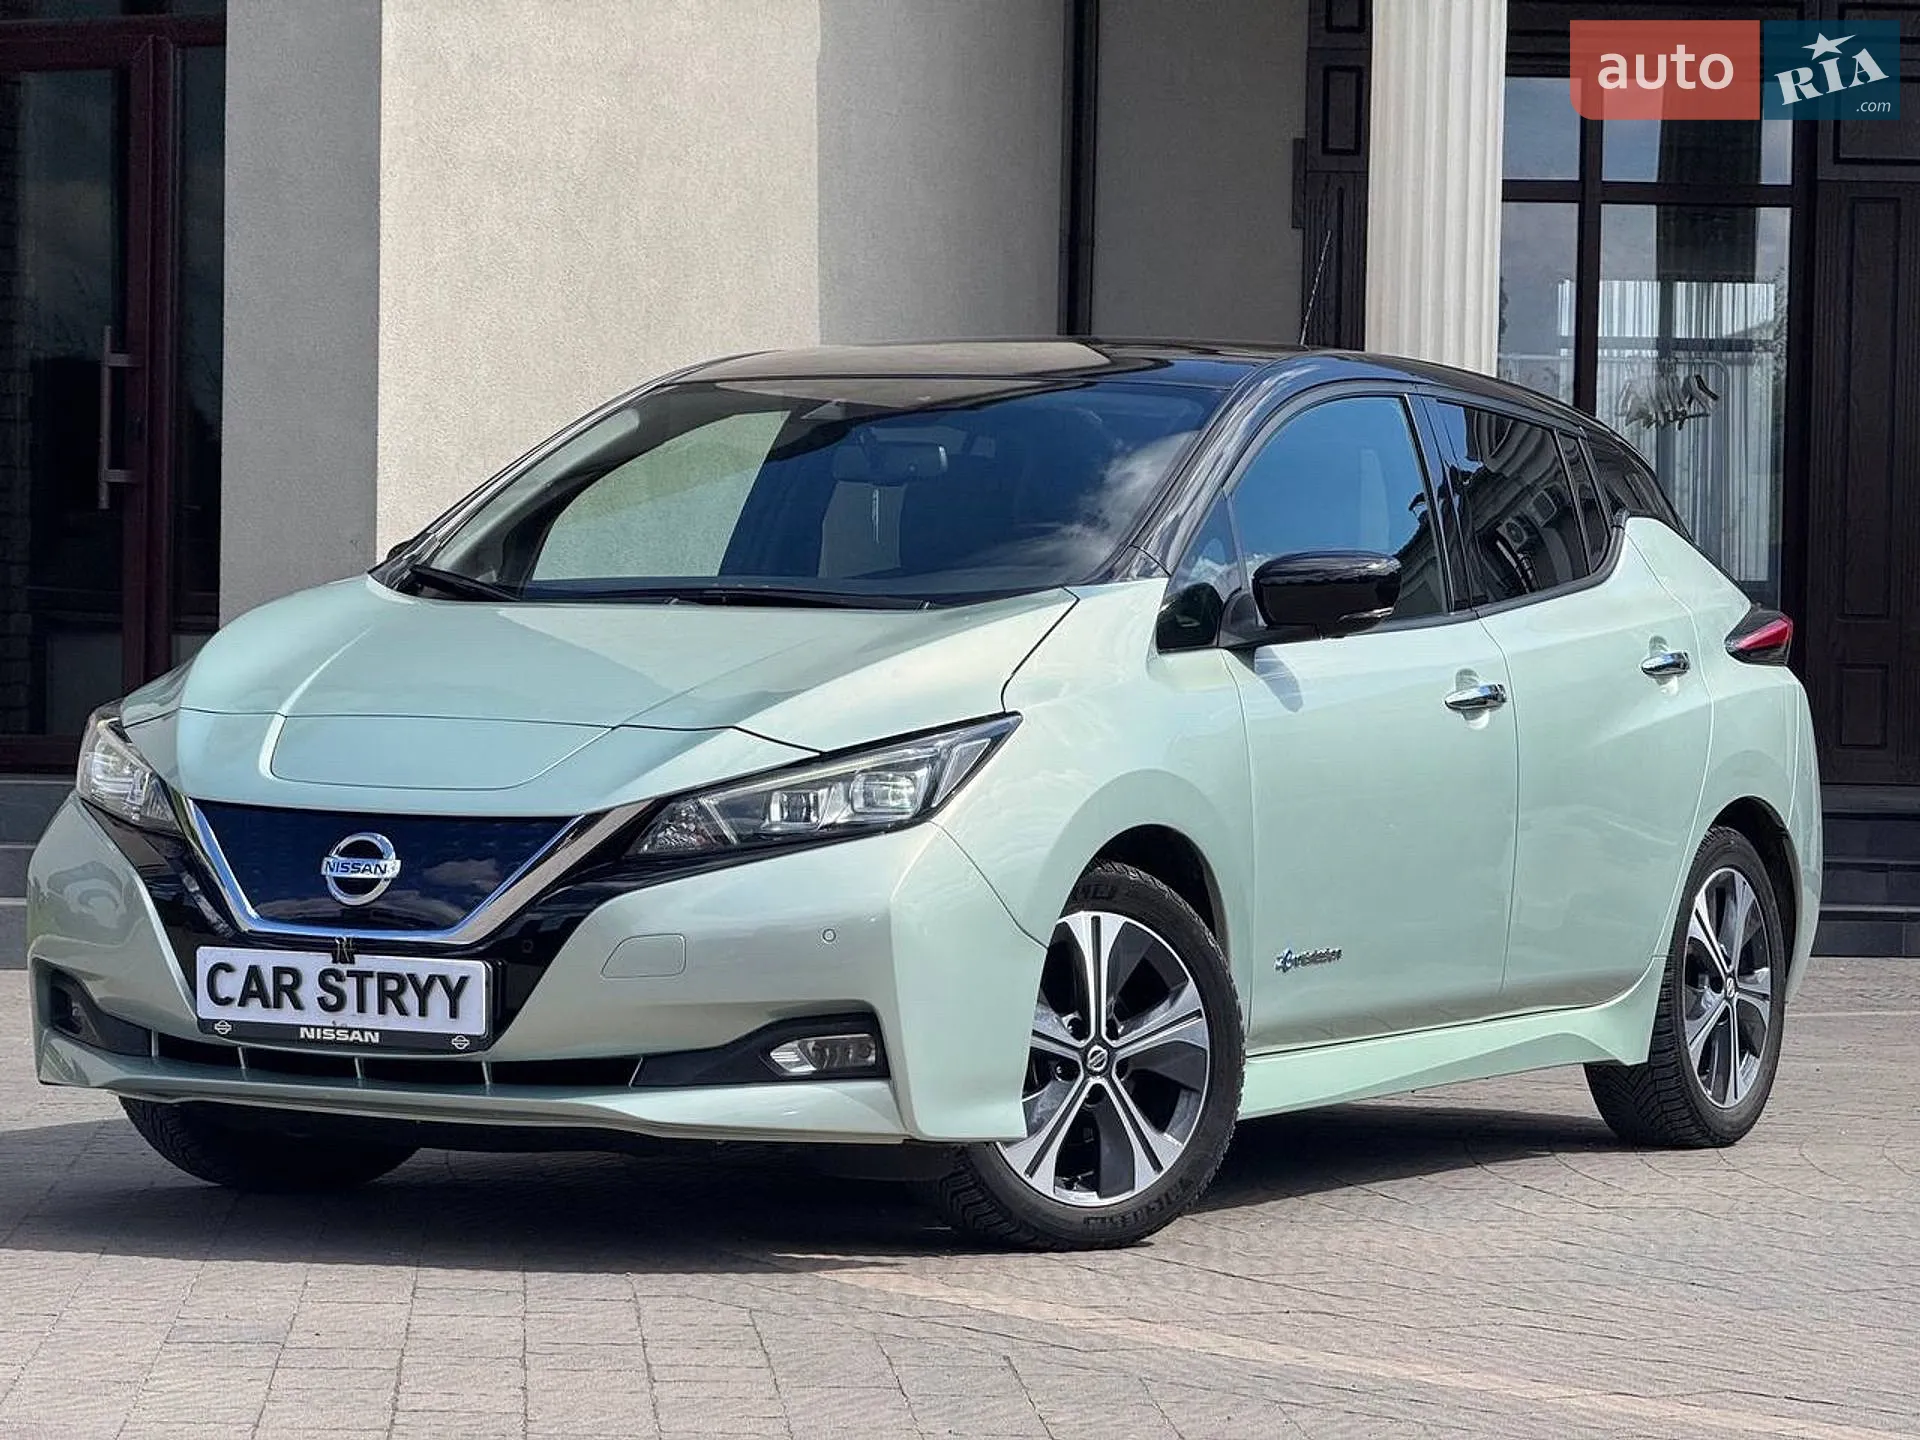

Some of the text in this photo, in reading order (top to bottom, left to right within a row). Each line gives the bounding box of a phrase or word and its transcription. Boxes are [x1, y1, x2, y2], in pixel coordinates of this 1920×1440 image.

[325, 861, 388, 875] NISSAN
[206, 961, 473, 1019] CAR STRYY
[299, 1026, 381, 1044] NISSAN
